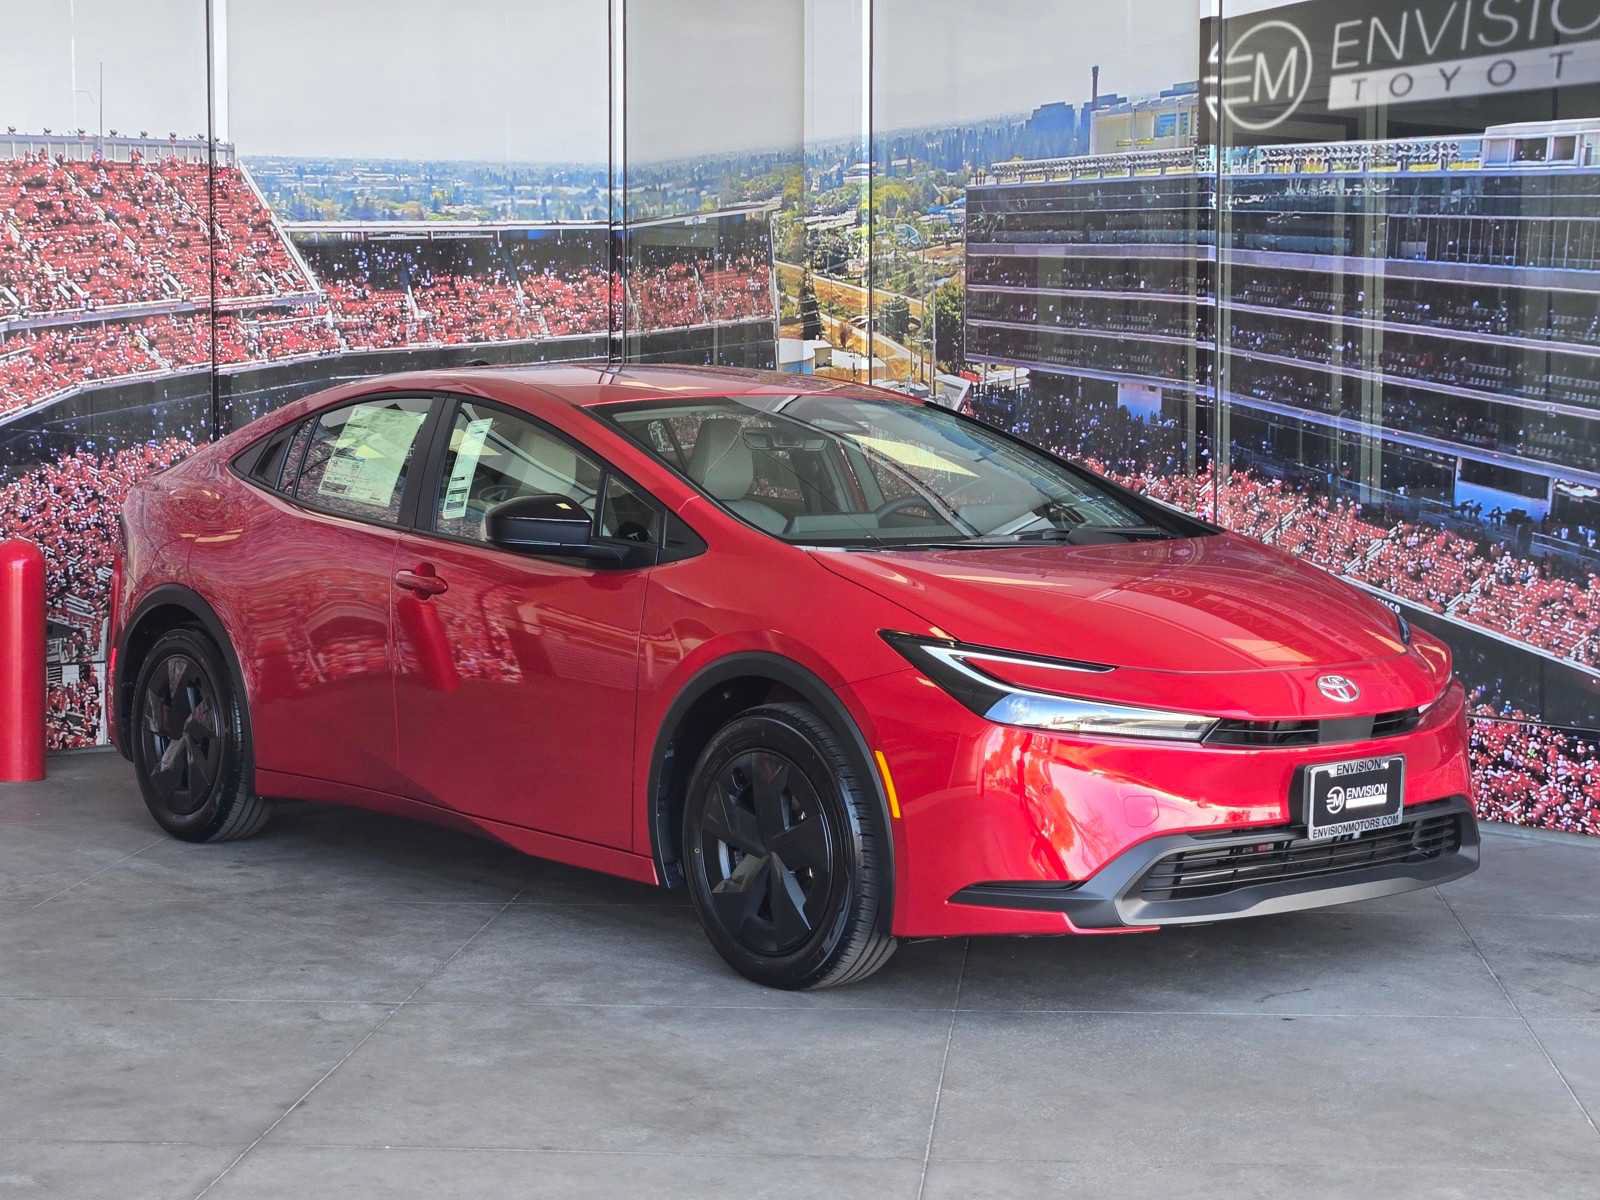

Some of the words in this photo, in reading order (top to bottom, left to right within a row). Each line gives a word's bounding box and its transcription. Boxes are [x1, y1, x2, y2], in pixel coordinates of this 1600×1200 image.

[1352, 51, 1574, 101] TOYOT
[1337, 760, 1381, 775] ENVISION
[1346, 783, 1388, 799] ENVISION
[1312, 815, 1399, 838] ENVISIONMOTORS.COM
